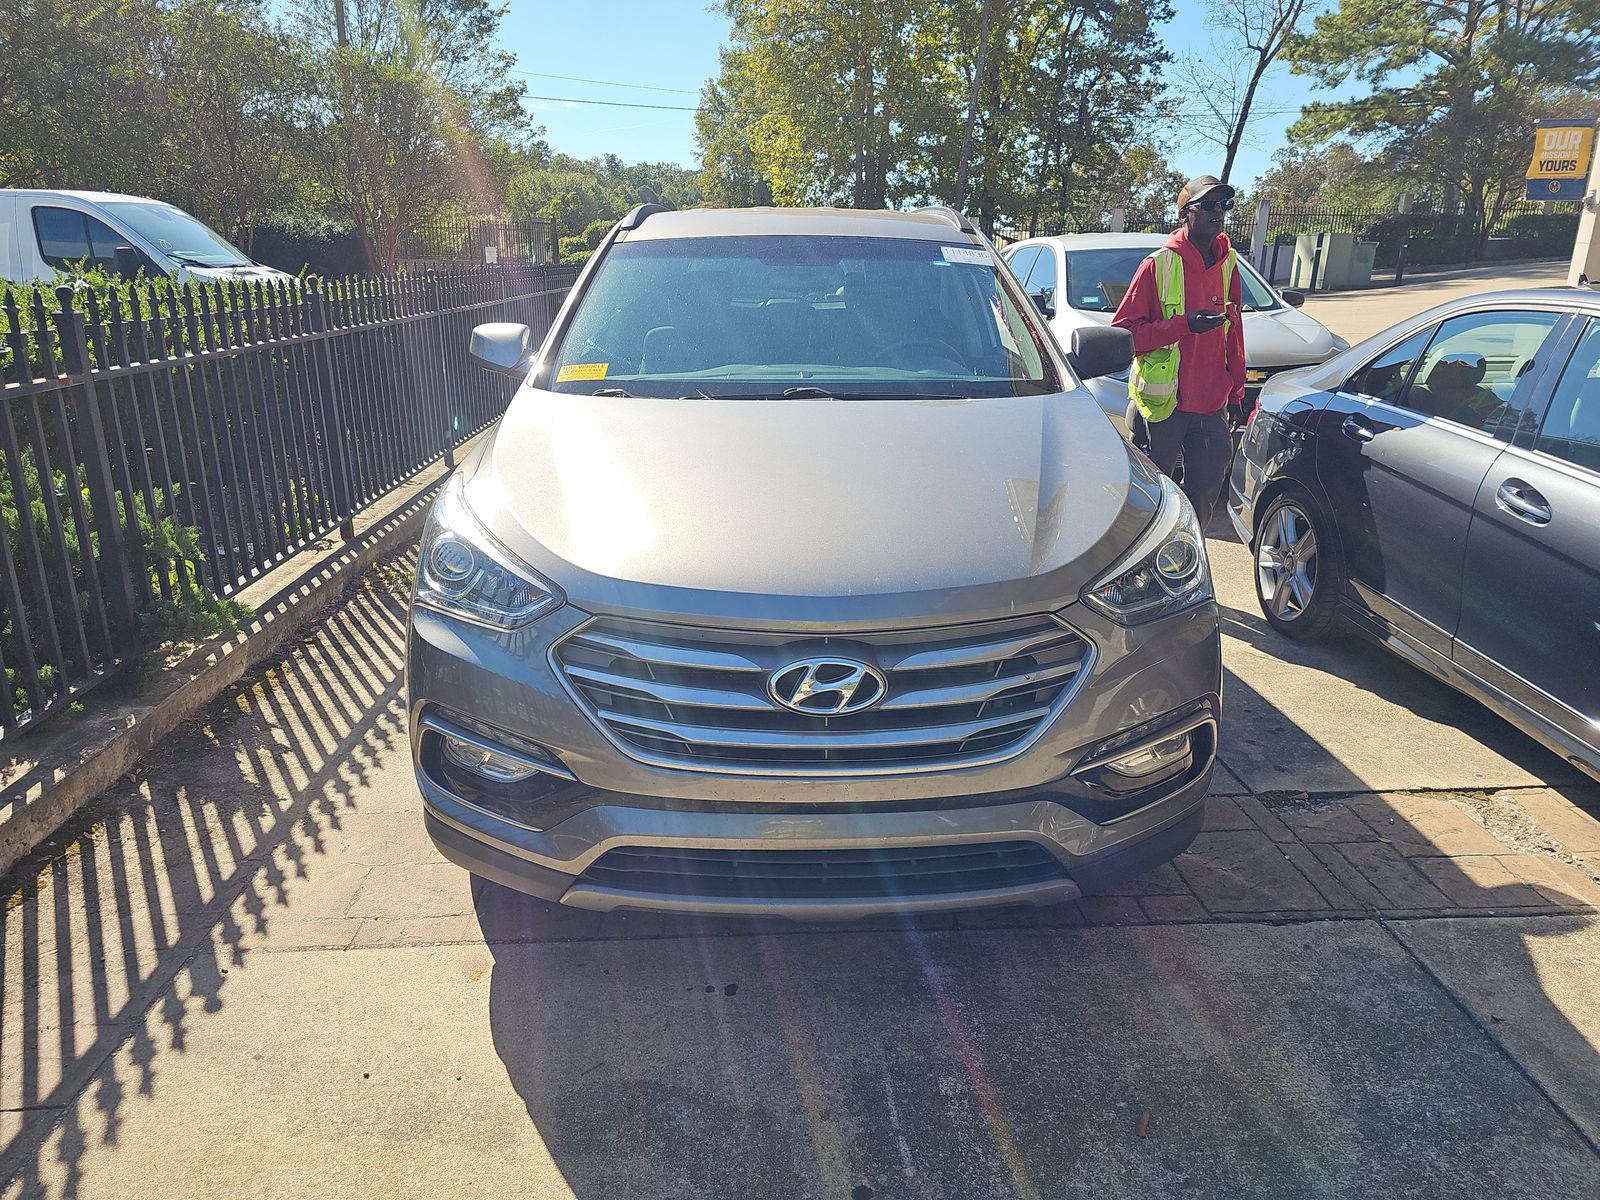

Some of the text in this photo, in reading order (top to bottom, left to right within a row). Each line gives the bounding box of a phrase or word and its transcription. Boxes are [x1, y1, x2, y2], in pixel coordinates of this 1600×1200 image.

[1544, 131, 1582, 150] OUR
[1571, 151, 1580, 159] IS
[1539, 160, 1577, 171] YOURS
